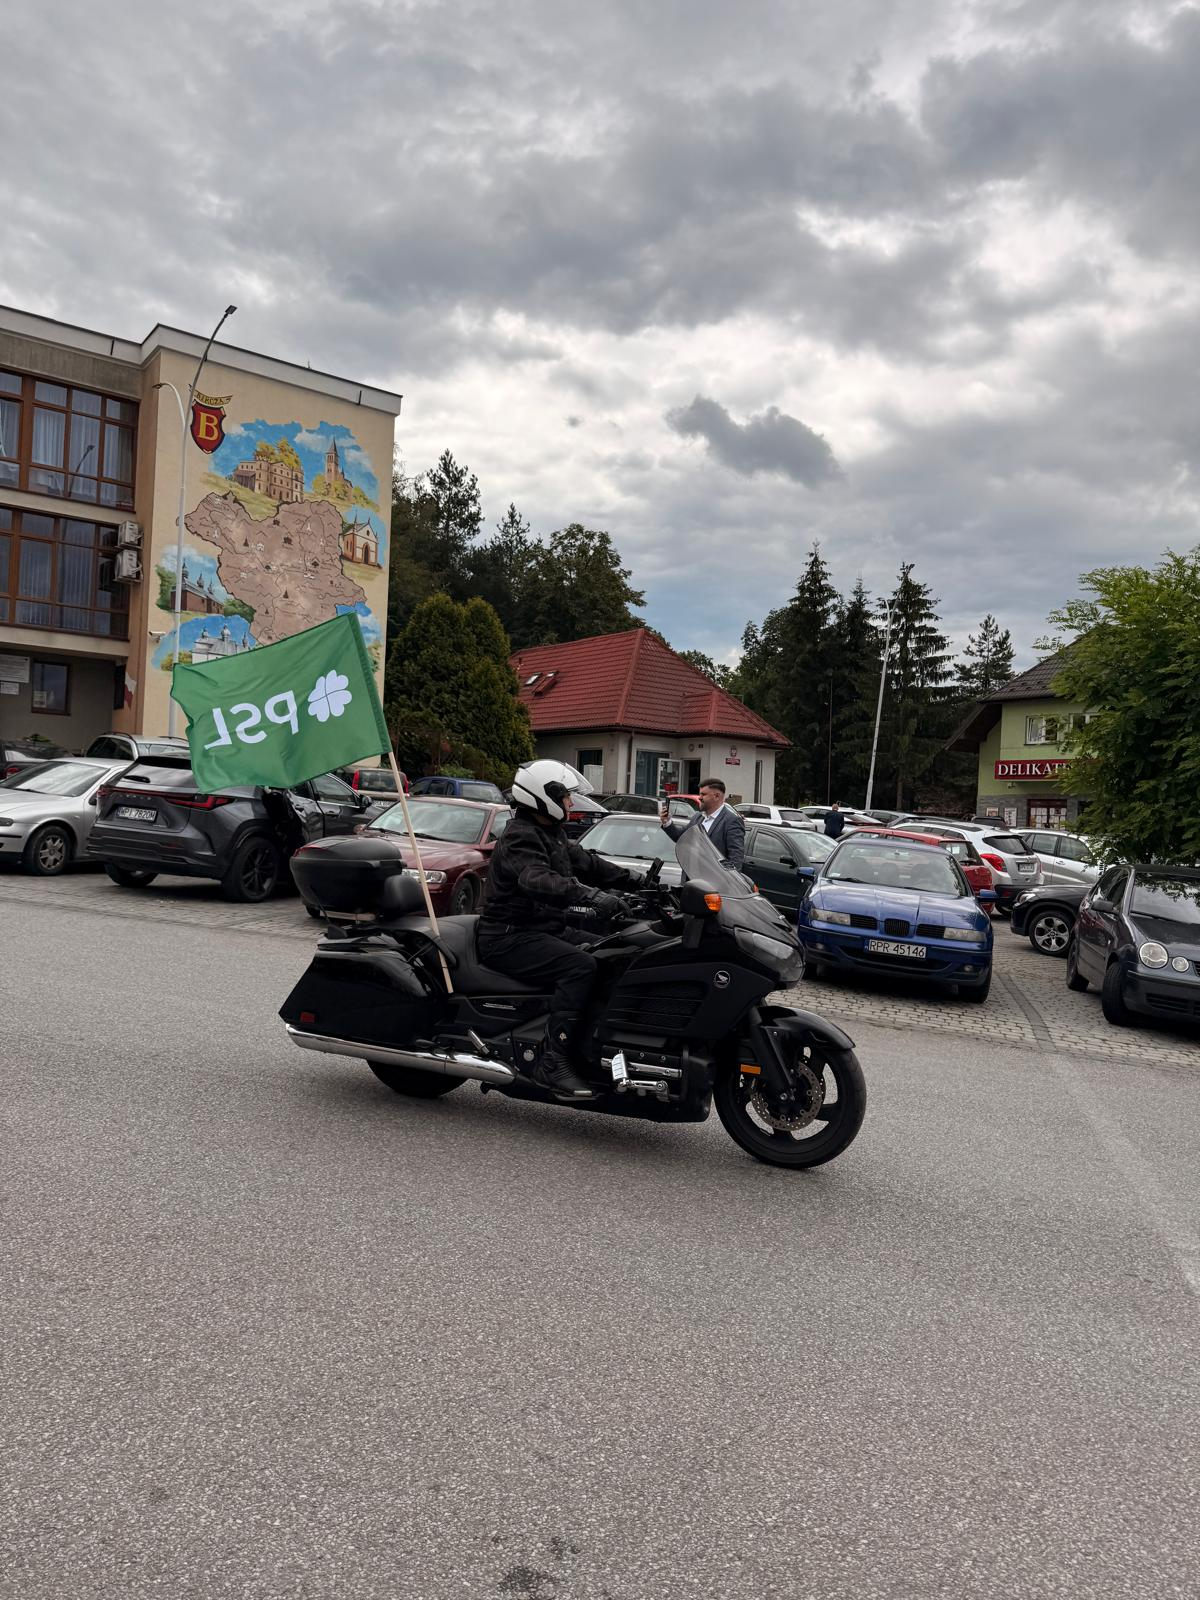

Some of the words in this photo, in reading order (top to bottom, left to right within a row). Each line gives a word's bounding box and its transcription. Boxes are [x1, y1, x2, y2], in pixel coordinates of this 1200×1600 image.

[198, 411, 219, 441] B
[998, 763, 1073, 775] DELIKAT
[870, 941, 890, 952] RPR
[892, 944, 925, 957] 45146
